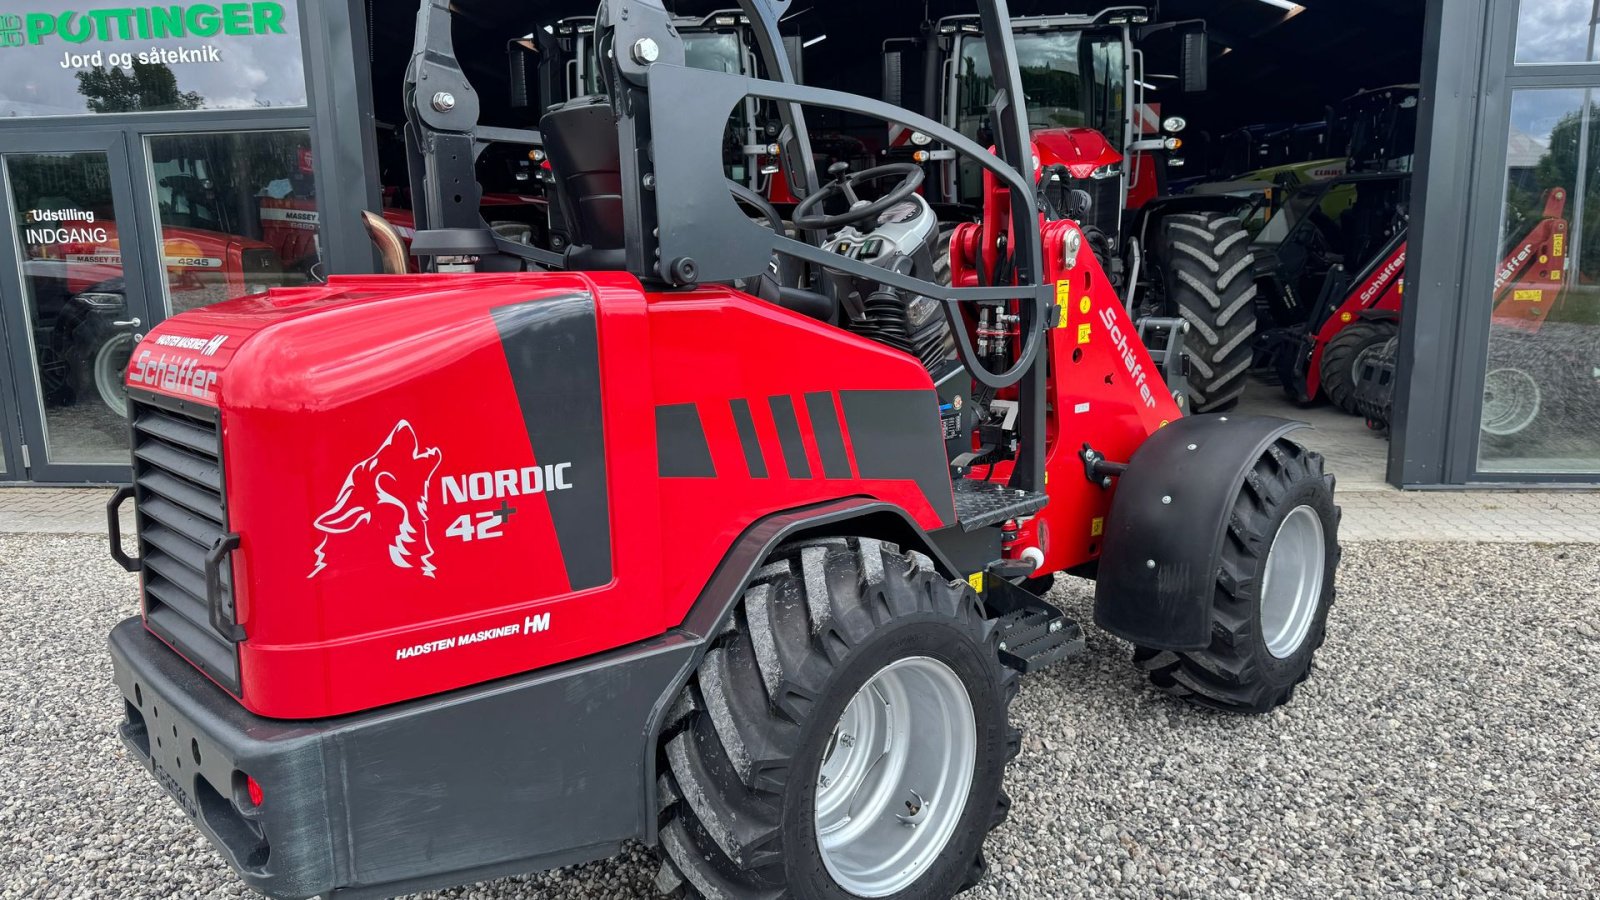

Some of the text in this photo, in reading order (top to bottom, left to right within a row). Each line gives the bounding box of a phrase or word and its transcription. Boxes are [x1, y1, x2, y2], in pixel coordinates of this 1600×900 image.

[60, 45, 220, 70] Jord og såteknik
[33, 208, 95, 223] Udstilling
[285, 212, 317, 221] MASSEY
[26, 228, 107, 244] INDGANG
[76, 256, 122, 264] MASSEY FE
[178, 258, 209, 267] 4245
[1360, 252, 1406, 306] Schäffer
[1098, 306, 1156, 409] Schäffer
[129, 349, 218, 398] Schäffer
[441, 461, 573, 505] NORDIC
[396, 612, 551, 660] HADSTEN MASKINER HM
